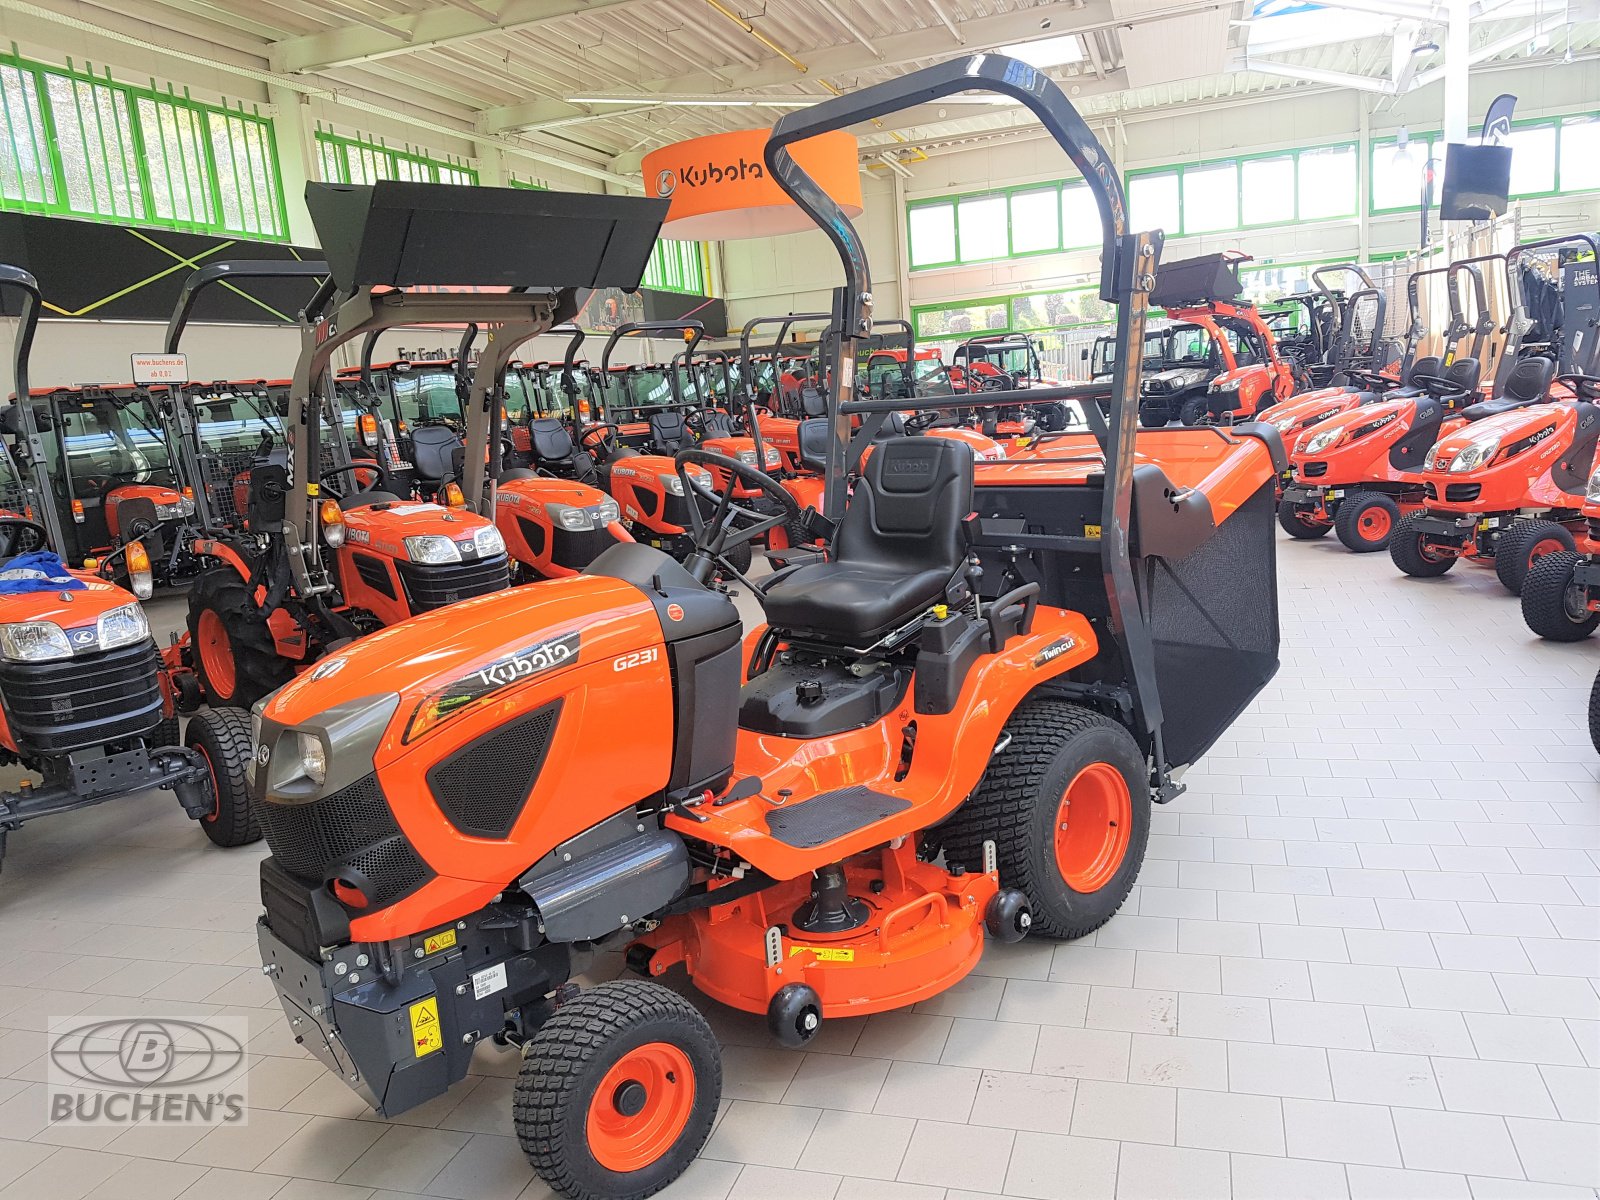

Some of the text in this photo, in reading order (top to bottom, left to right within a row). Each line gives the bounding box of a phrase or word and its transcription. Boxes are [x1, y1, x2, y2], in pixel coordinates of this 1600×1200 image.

[680, 158, 763, 187] Kubota
[1574, 269, 1591, 277] THE
[397, 347, 416, 360] For
[418, 348, 447, 360] Earth
[136, 358, 184, 366] www.buchens.de
[1318, 407, 1340, 420] Kubota
[1373, 414, 1396, 428] Kubota
[1529, 427, 1555, 443] Kubota
[612, 467, 636, 477] KUBOTA
[345, 527, 370, 545] UBOTA
[479, 643, 571, 685] Kubota
[613, 647, 658, 672] G231
